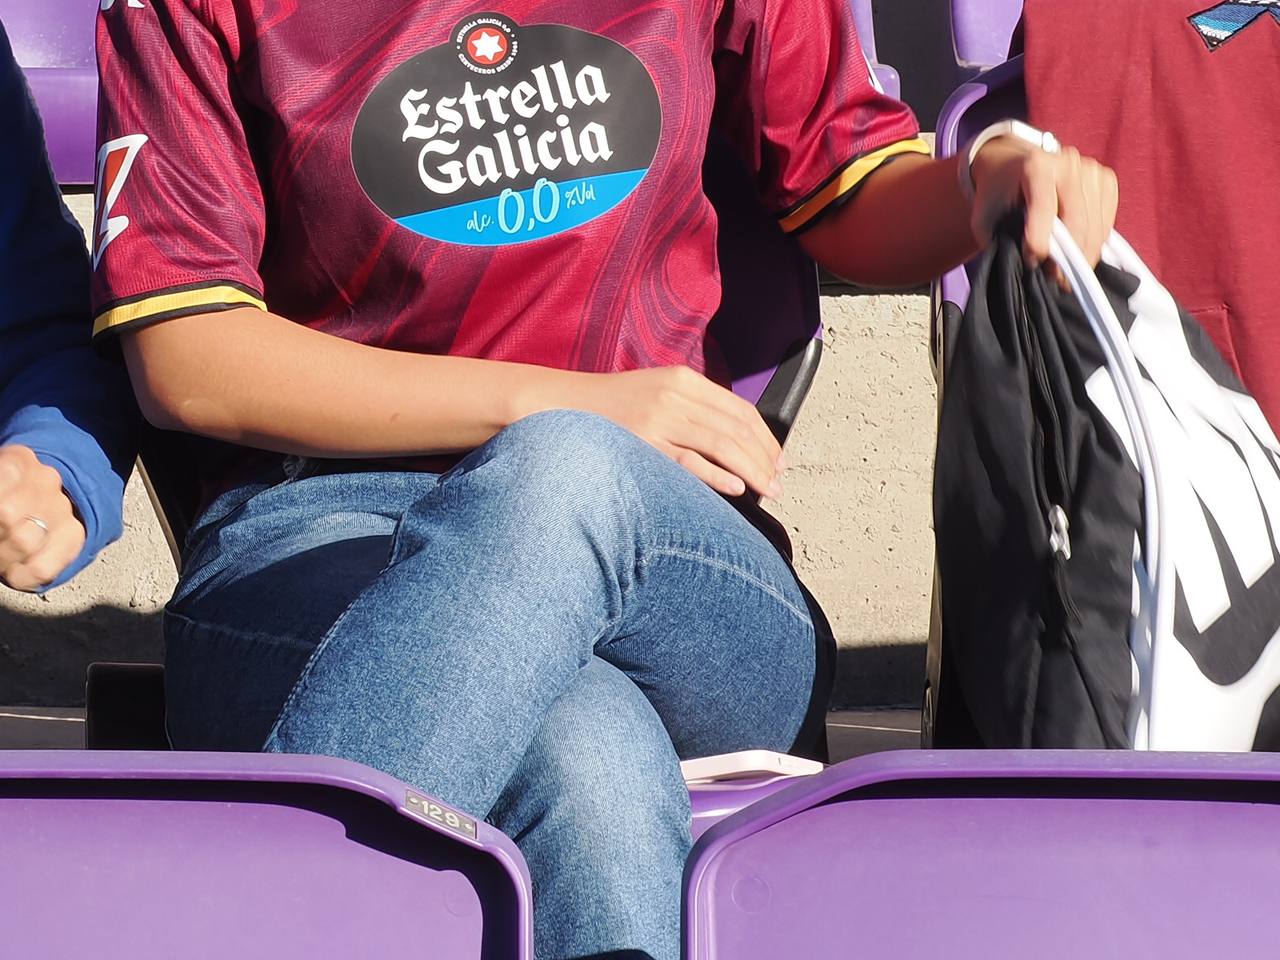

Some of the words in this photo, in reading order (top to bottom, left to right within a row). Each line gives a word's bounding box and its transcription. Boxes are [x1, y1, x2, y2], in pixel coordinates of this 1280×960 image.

[476, 18, 502, 27] GALICIA
[399, 60, 611, 142] Estrella
[418, 114, 614, 194] Galicia
[498, 177, 560, 234] 0,0
[422, 800, 460, 828] 129
